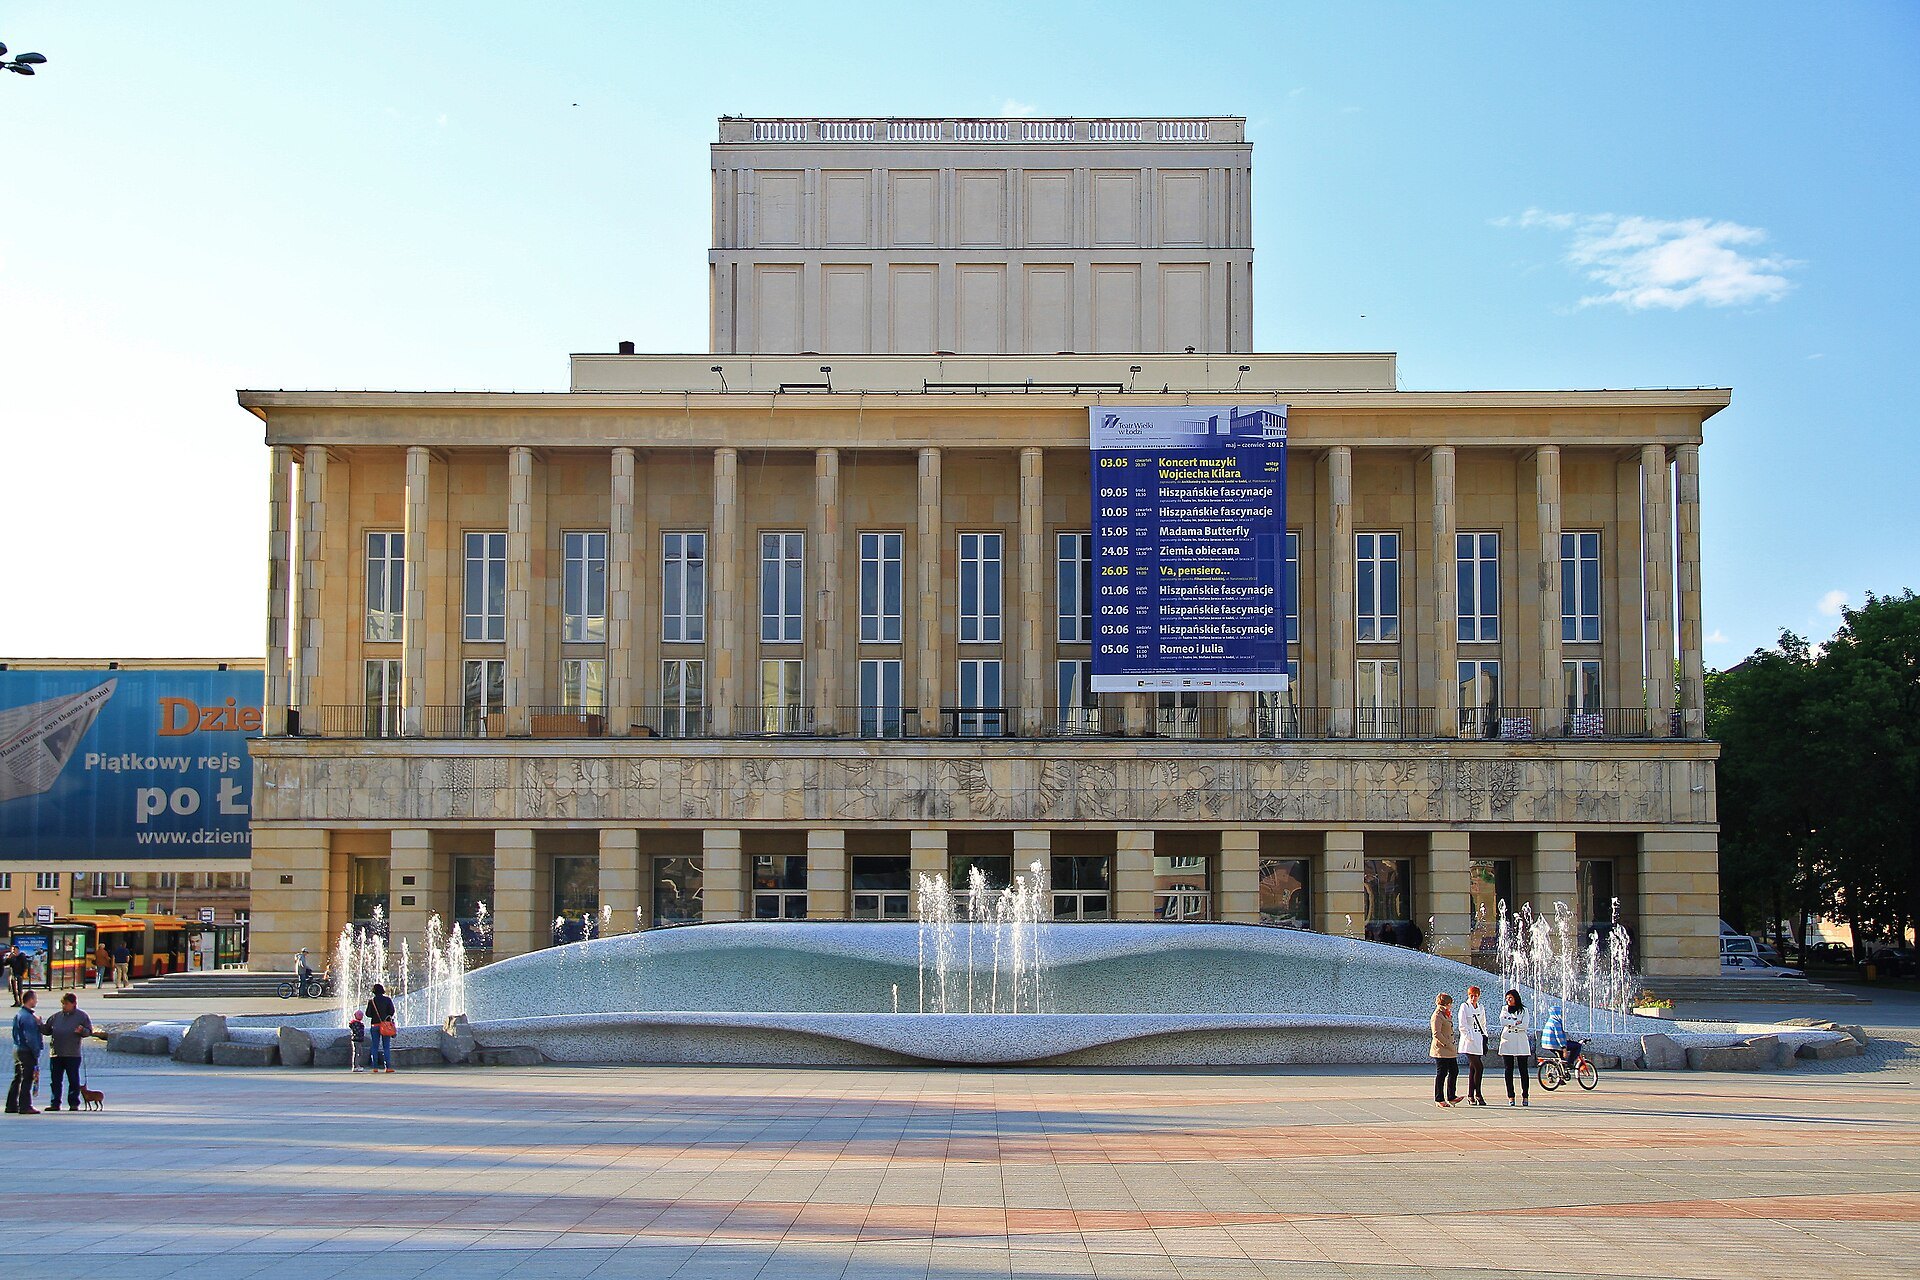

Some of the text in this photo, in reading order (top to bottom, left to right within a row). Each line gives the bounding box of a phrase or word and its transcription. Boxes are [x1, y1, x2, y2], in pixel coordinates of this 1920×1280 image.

[1101, 458, 1127, 467] 03.05
[1159, 457, 1236, 468] Koncert muzyki
[1159, 469, 1241, 480] Wojciecha Kilara
[1101, 488, 1127, 497] 09.05
[1159, 487, 1272, 499] Hiszpańskie fascynacje
[1102, 508, 1127, 516] 10.05
[1159, 506, 1272, 519] Hiszpańskie fascynacje
[1102, 527, 1128, 536] 15.05
[1160, 526, 1249, 537] Madama Butterfly
[1102, 547, 1128, 555] 24.05
[1160, 546, 1240, 555] Ziemia obiecana
[1102, 567, 1128, 575] 26.05
[1160, 566, 1230, 578] Va, pensiero...
[1102, 586, 1129, 595] 01.06
[1160, 585, 1273, 598] Hiszpańskie fascynacje
[1102, 606, 1128, 614] 02.06
[1160, 605, 1273, 617] Hiszpańskie fascynacje
[1102, 625, 1129, 634] 03.06
[1160, 624, 1273, 636] Hiszpańskie fascynacje
[1101, 645, 1129, 653] 05.06
[1160, 644, 1223, 654] Romeo i Julia
[44, 720, 59, 731] syn
[58, 704, 84, 721] tkacza
[158, 696, 264, 736] Dzie
[84, 752, 241, 774] Piątkowy rejs
[136, 786, 200, 824] po
